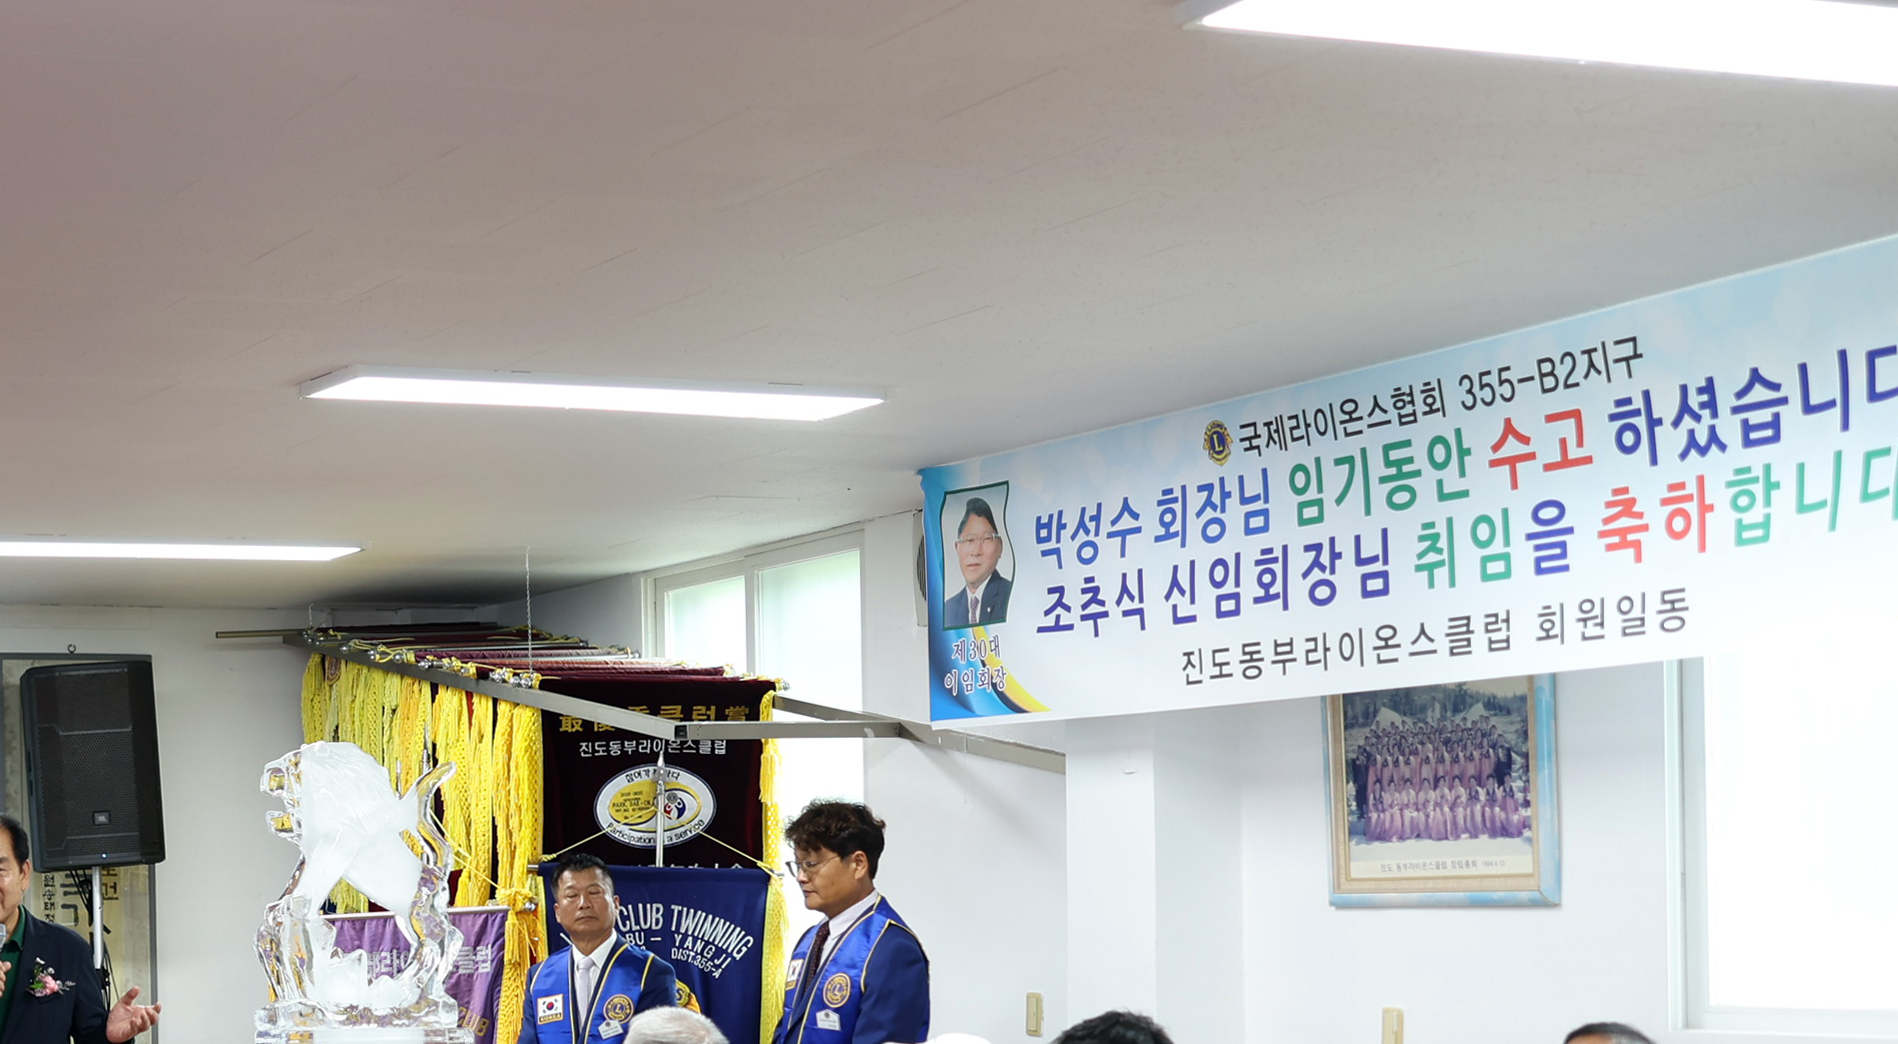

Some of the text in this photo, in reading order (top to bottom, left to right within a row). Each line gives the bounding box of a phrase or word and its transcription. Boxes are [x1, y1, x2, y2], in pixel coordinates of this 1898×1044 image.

[1239, 336, 1644, 457] 국제라이온스협회 355-B2지구
[1035, 497, 1143, 570] 박성수
[1153, 467, 1271, 549] 회장님
[1288, 426, 1472, 527] 임기동안
[1488, 407, 1594, 492] 수고
[1036, 446, 1898, 638] 조추식 신임회장님 취임을 축하합니다
[944, 664, 1007, 697] 이임회장
[951, 634, 1001, 664] 제30대
[1181, 586, 1690, 686] 진도동부라이온스클럽 회원일동
[616, 903, 754, 961] CLUB TWINNING
